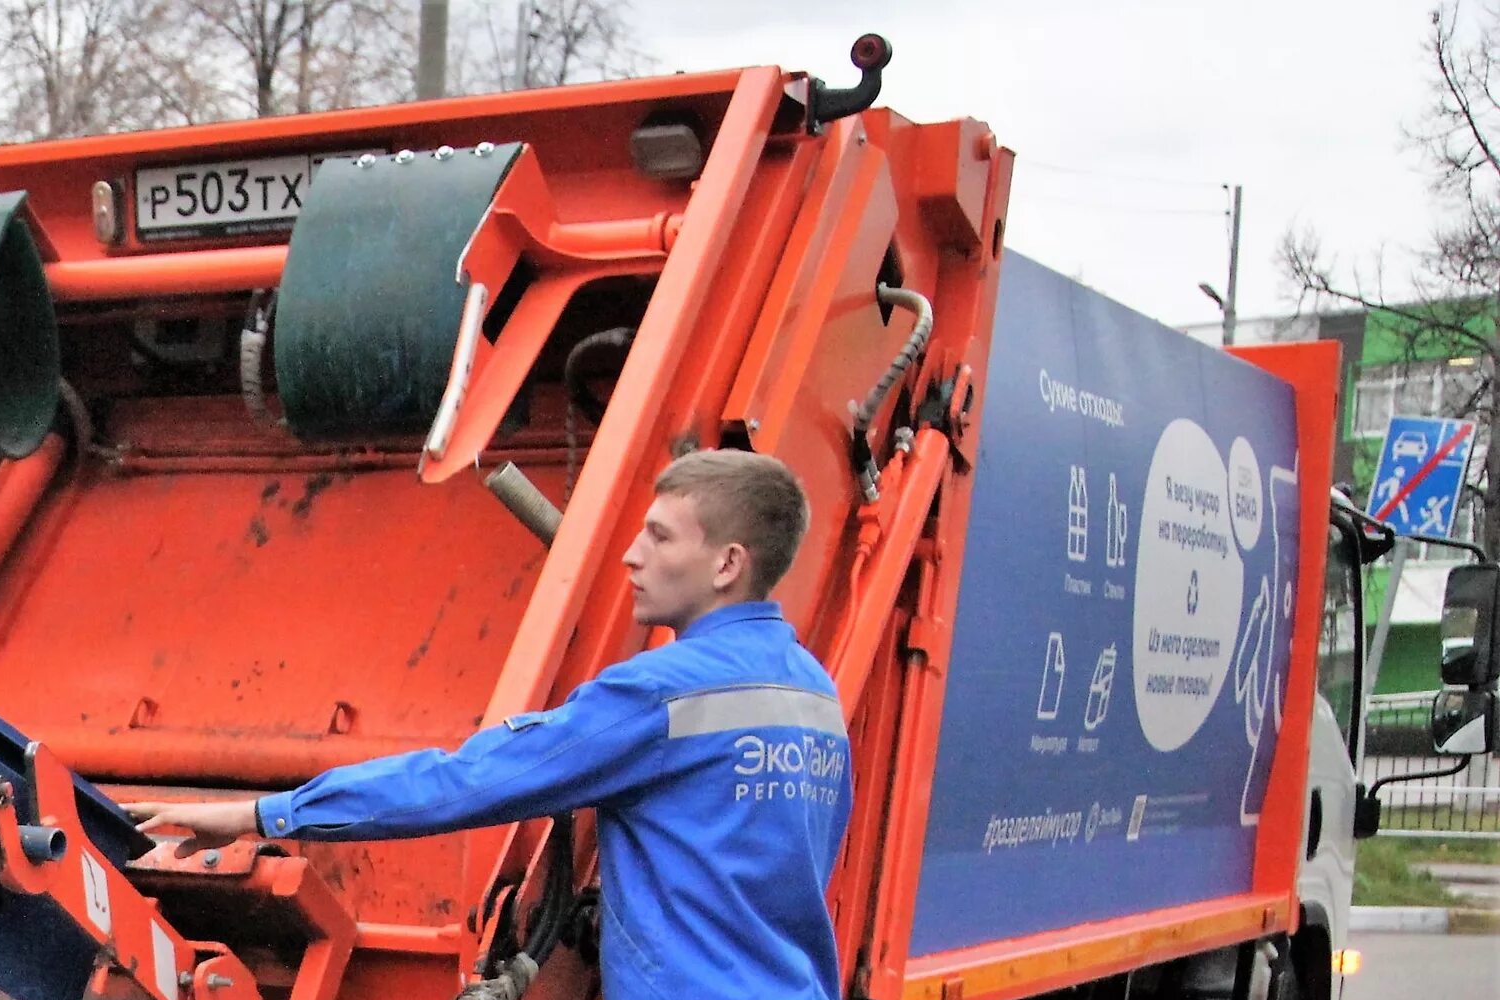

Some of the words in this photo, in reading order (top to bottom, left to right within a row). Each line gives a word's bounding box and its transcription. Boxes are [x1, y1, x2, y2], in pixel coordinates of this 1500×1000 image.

[150, 167, 303, 220] Р503ТХ
[1039, 367, 1077, 414] Сухие
[1165, 475, 1173, 500] Я
[1173, 481, 1193, 512] везу
[1194, 487, 1220, 520] мусор
[1158, 520, 1171, 541] на
[1147, 627, 1161, 653] Из
[1160, 633, 1182, 655] него
[1145, 674, 1175, 695] новые
